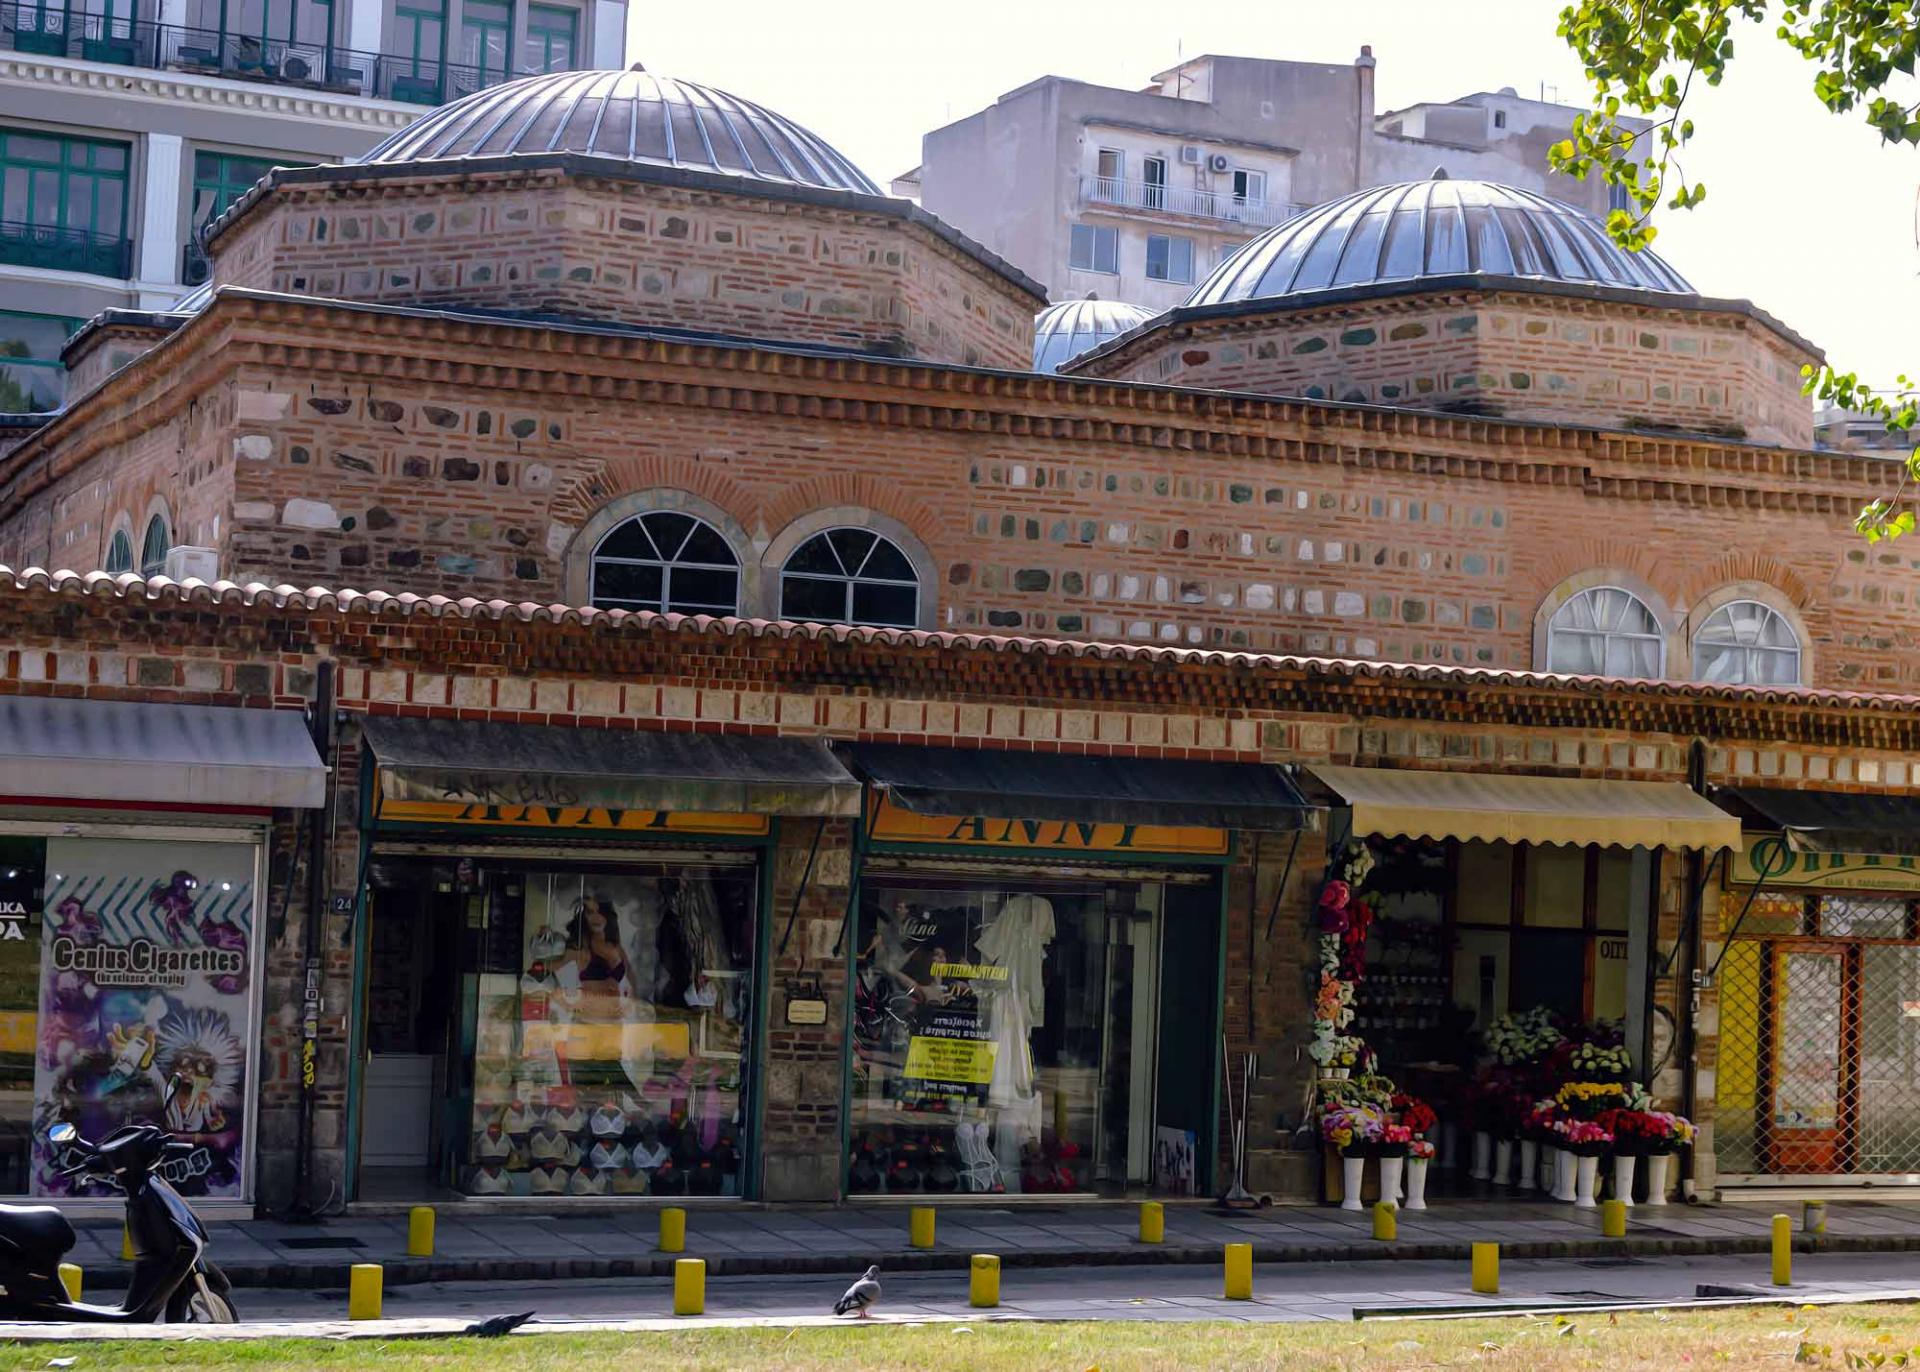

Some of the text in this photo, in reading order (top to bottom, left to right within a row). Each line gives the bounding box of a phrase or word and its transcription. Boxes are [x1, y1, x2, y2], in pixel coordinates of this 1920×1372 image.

[337, 897, 352, 910] 24
[54, 938, 242, 973] Genius Cigarettes
[97, 973, 185, 986] the science of vaping
